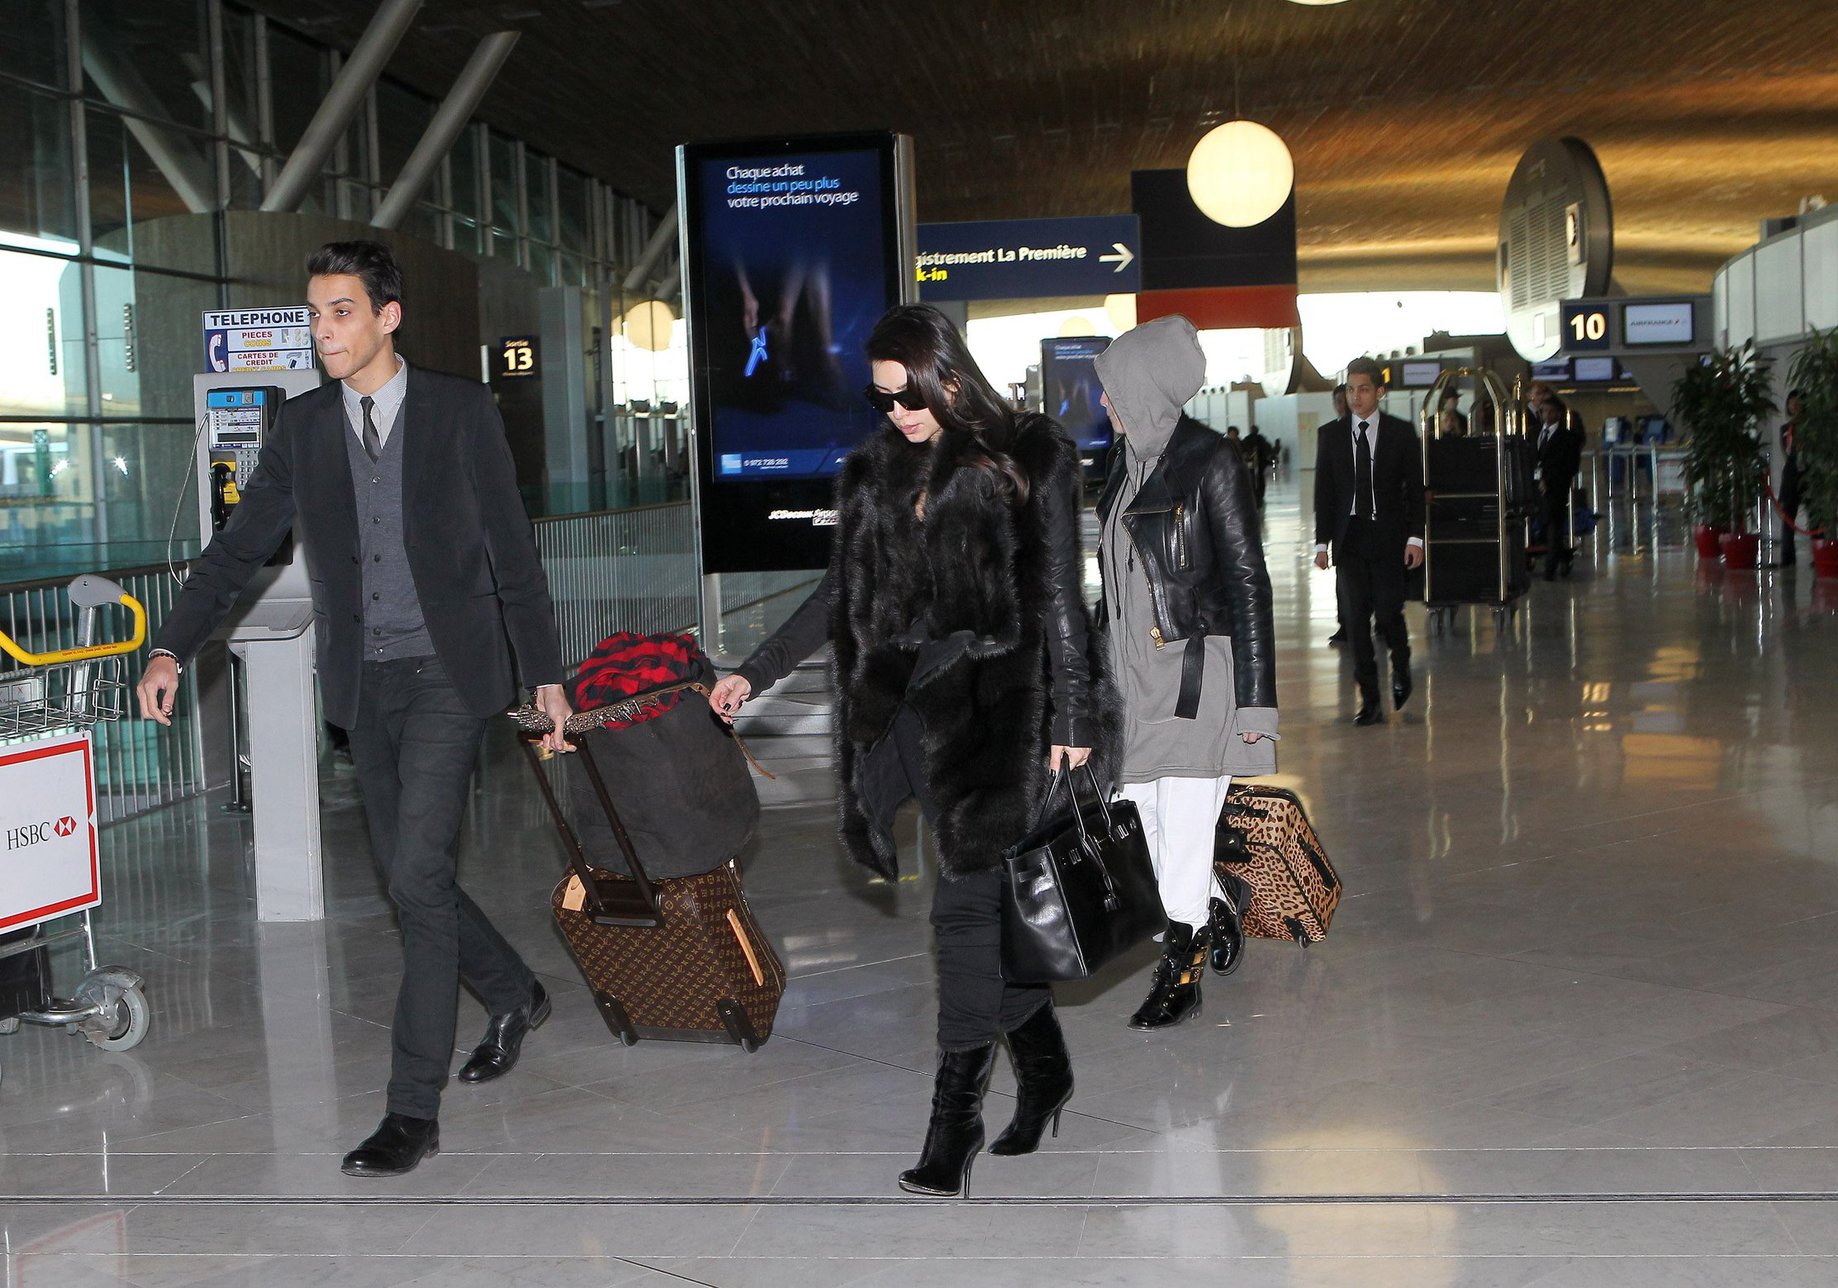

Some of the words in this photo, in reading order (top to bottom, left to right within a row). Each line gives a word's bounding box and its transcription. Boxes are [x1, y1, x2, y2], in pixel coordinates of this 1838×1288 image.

[726, 166, 771, 180] Chaque
[772, 163, 804, 177] achat
[726, 181, 771, 194] dessine
[772, 182, 788, 192] un
[790, 180, 812, 193] peu
[814, 176, 840, 191] plus
[727, 196, 759, 208] votre
[760, 192, 813, 209] prochain
[814, 191, 859, 206] voyage
[997, 248, 1017, 262] La
[1018, 244, 1087, 261] Première
[210, 311, 304, 326] TELEPHONE
[1569, 313, 1606, 341] 10
[241, 331, 273, 339] PIECES
[237, 352, 267, 360] CARTES
[268, 351, 279, 359] DE
[245, 359, 273, 367] CREDIT
[503, 347, 533, 370] 13
[7, 821, 50, 850] HSBC
